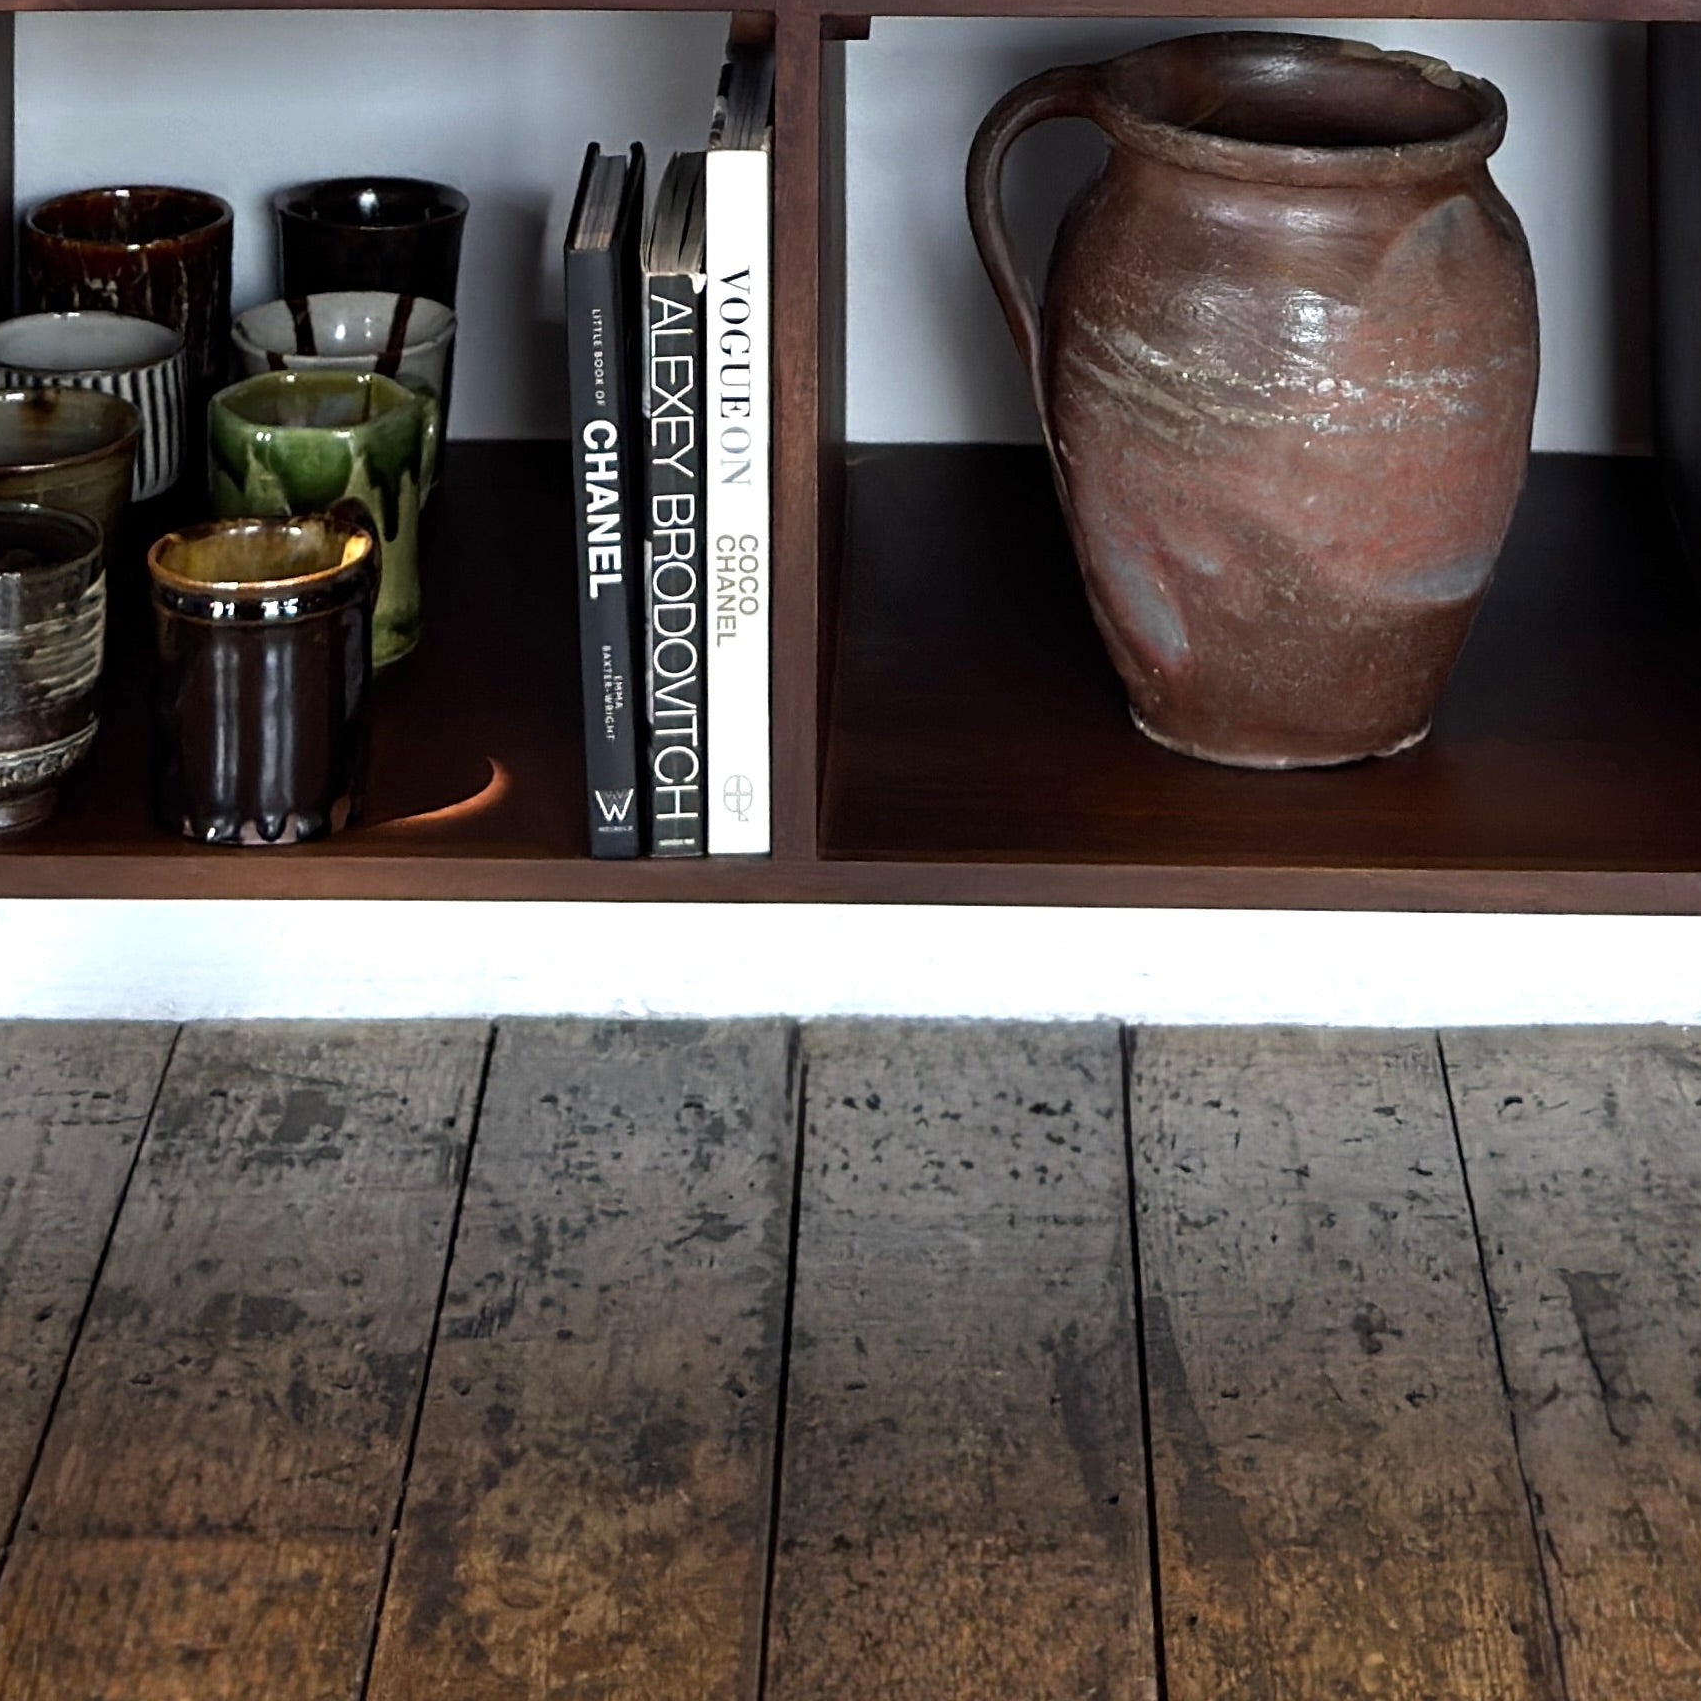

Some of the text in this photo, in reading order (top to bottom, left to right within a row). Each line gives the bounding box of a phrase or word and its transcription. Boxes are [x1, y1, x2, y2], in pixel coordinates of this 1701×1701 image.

[590, 308, 606, 408] LITTLE BOOK OF
[650, 294, 695, 480] ALEXEY
[719, 265, 752, 486] VOGUE ON
[583, 418, 622, 599] CHANEL
[716, 534, 737, 649] CHANEL
[738, 534, 759, 617] COCO
[651, 493, 699, 821] BRODOVITCH
